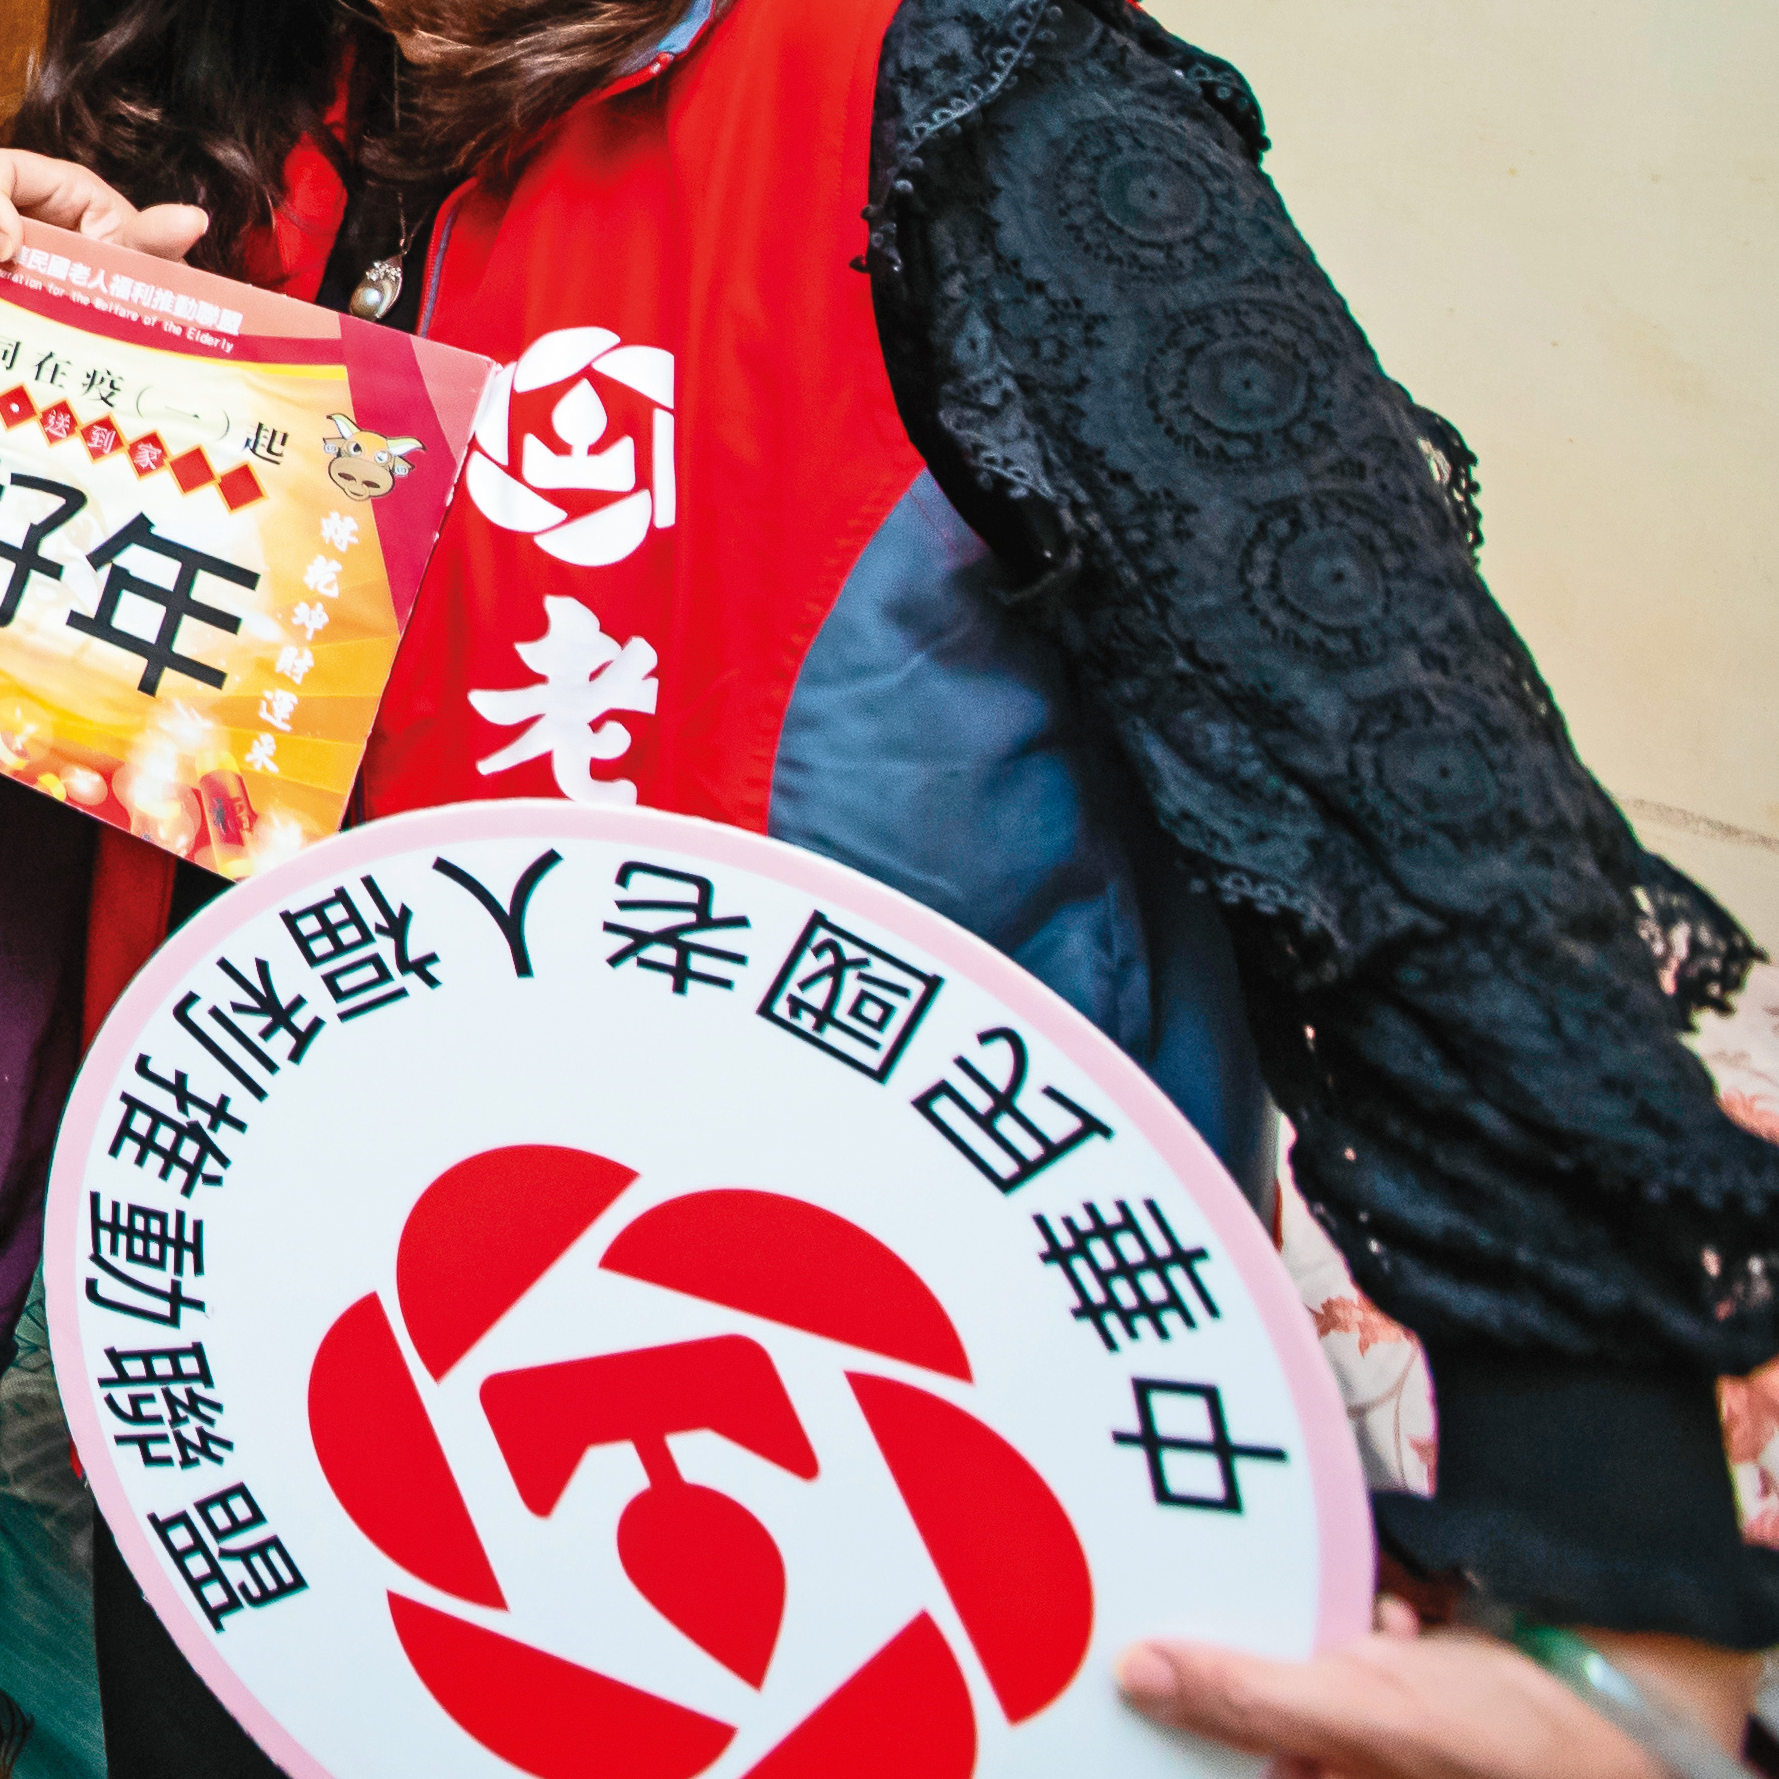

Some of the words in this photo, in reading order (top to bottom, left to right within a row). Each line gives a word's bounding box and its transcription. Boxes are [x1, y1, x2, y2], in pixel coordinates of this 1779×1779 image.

[48, 282, 66, 299] for
[71, 290, 91, 306] the
[94, 296, 140, 322] Welfare
[143, 313, 159, 327] of
[164, 319, 184, 336] the
[186, 329, 235, 354] Elderly
[467, 594, 659, 806] 老
[82, 848, 1288, 1635] 中華民國老人福利推動聯盟
